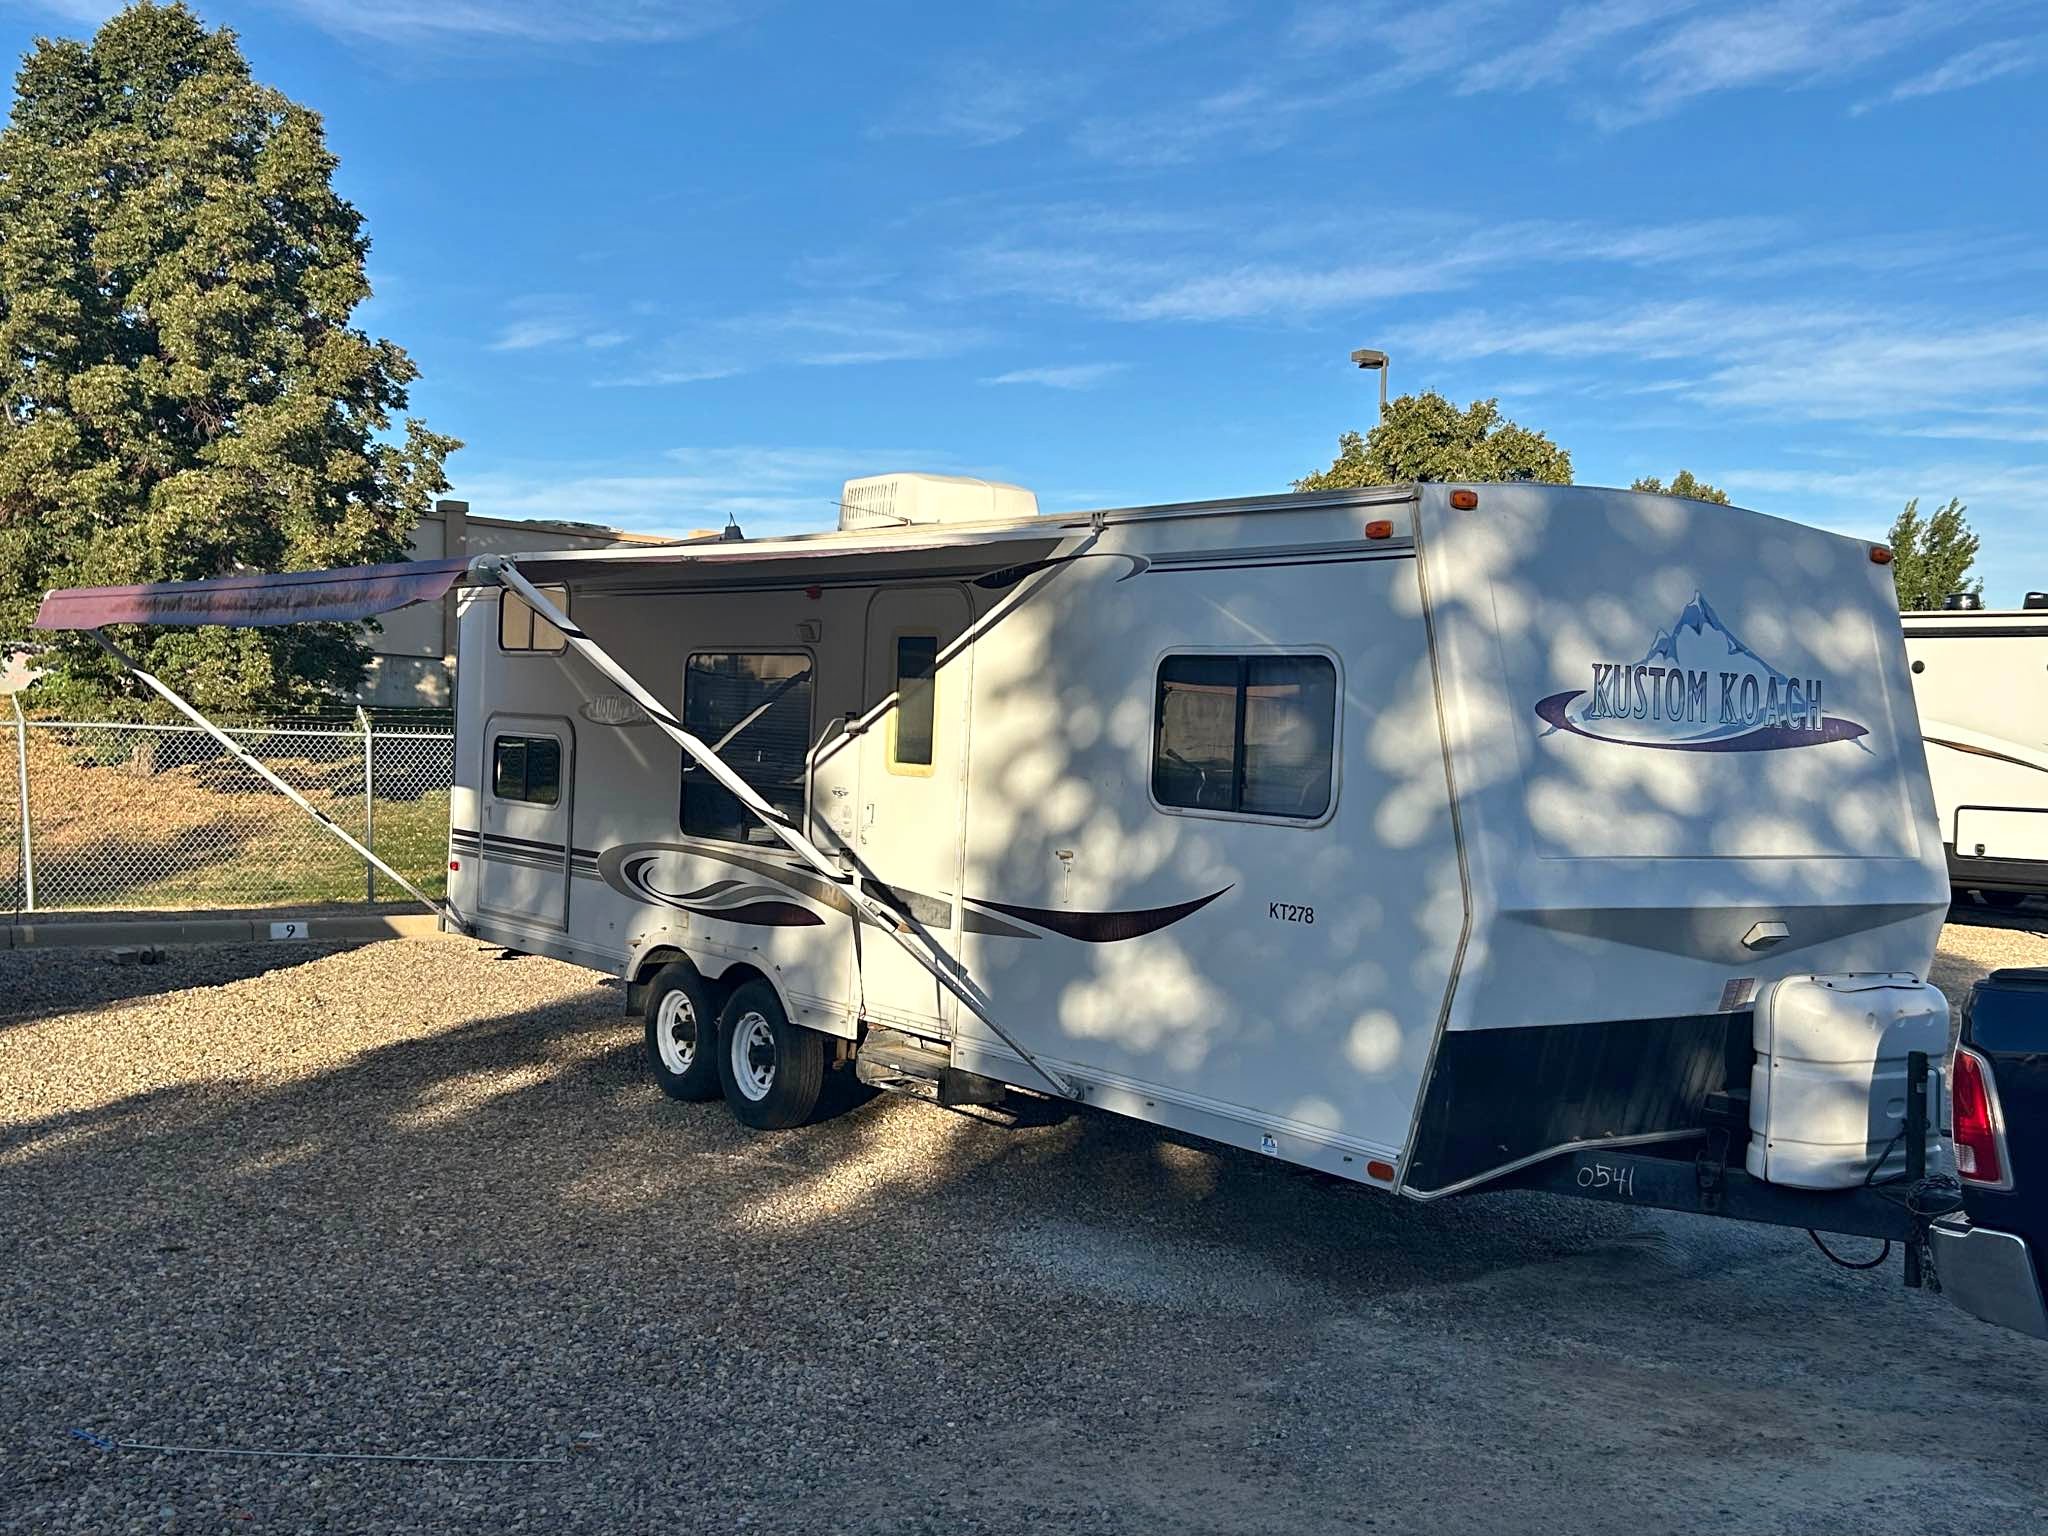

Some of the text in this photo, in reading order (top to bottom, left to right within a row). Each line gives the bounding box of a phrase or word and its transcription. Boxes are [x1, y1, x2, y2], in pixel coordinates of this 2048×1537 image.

[1591, 663, 1824, 731] KUSTOM KOACH
[1269, 902, 1314, 924] KT278
[286, 924, 296, 938] 9
[1577, 1163, 1634, 1196] 0541
